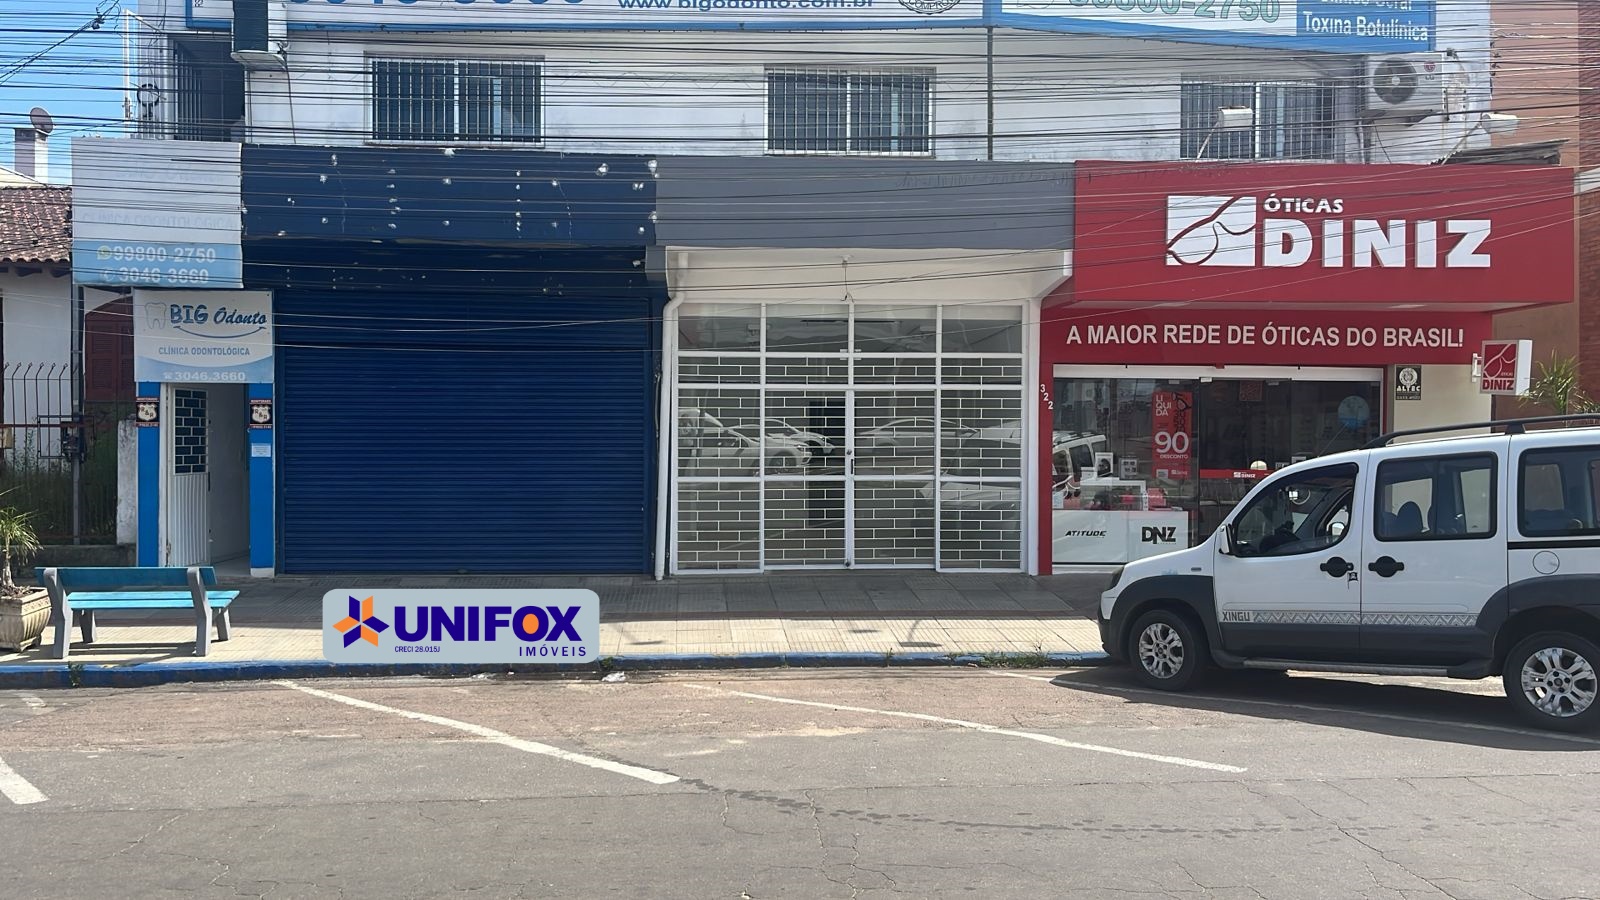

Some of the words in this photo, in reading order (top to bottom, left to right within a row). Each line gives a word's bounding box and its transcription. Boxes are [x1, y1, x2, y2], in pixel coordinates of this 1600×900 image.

[1303, 11, 1351, 35] Toxina
[1356, 16, 1428, 41] Botulínica
[1263, 193, 1344, 213] ÓTICAS
[1262, 218, 1492, 268] DINIZ
[170, 304, 209, 325] BIG
[1066, 325, 1082, 344] A
[1087, 324, 1158, 344] MAIOR
[1163, 324, 1221, 344] REDE
[1227, 325, 1255, 344] DE
[1261, 321, 1340, 345] ÓTICAS
[1346, 327, 1377, 346] DO
[1383, 328, 1464, 347] BRASIL!
[158, 345, 189, 355] CLÍNICA
[191, 346, 250, 356] ODONTOLÓGICA
[1482, 379, 1514, 391] DINIZ
[1154, 431, 1189, 454] 90
[1222, 611, 1251, 622] XINGU
